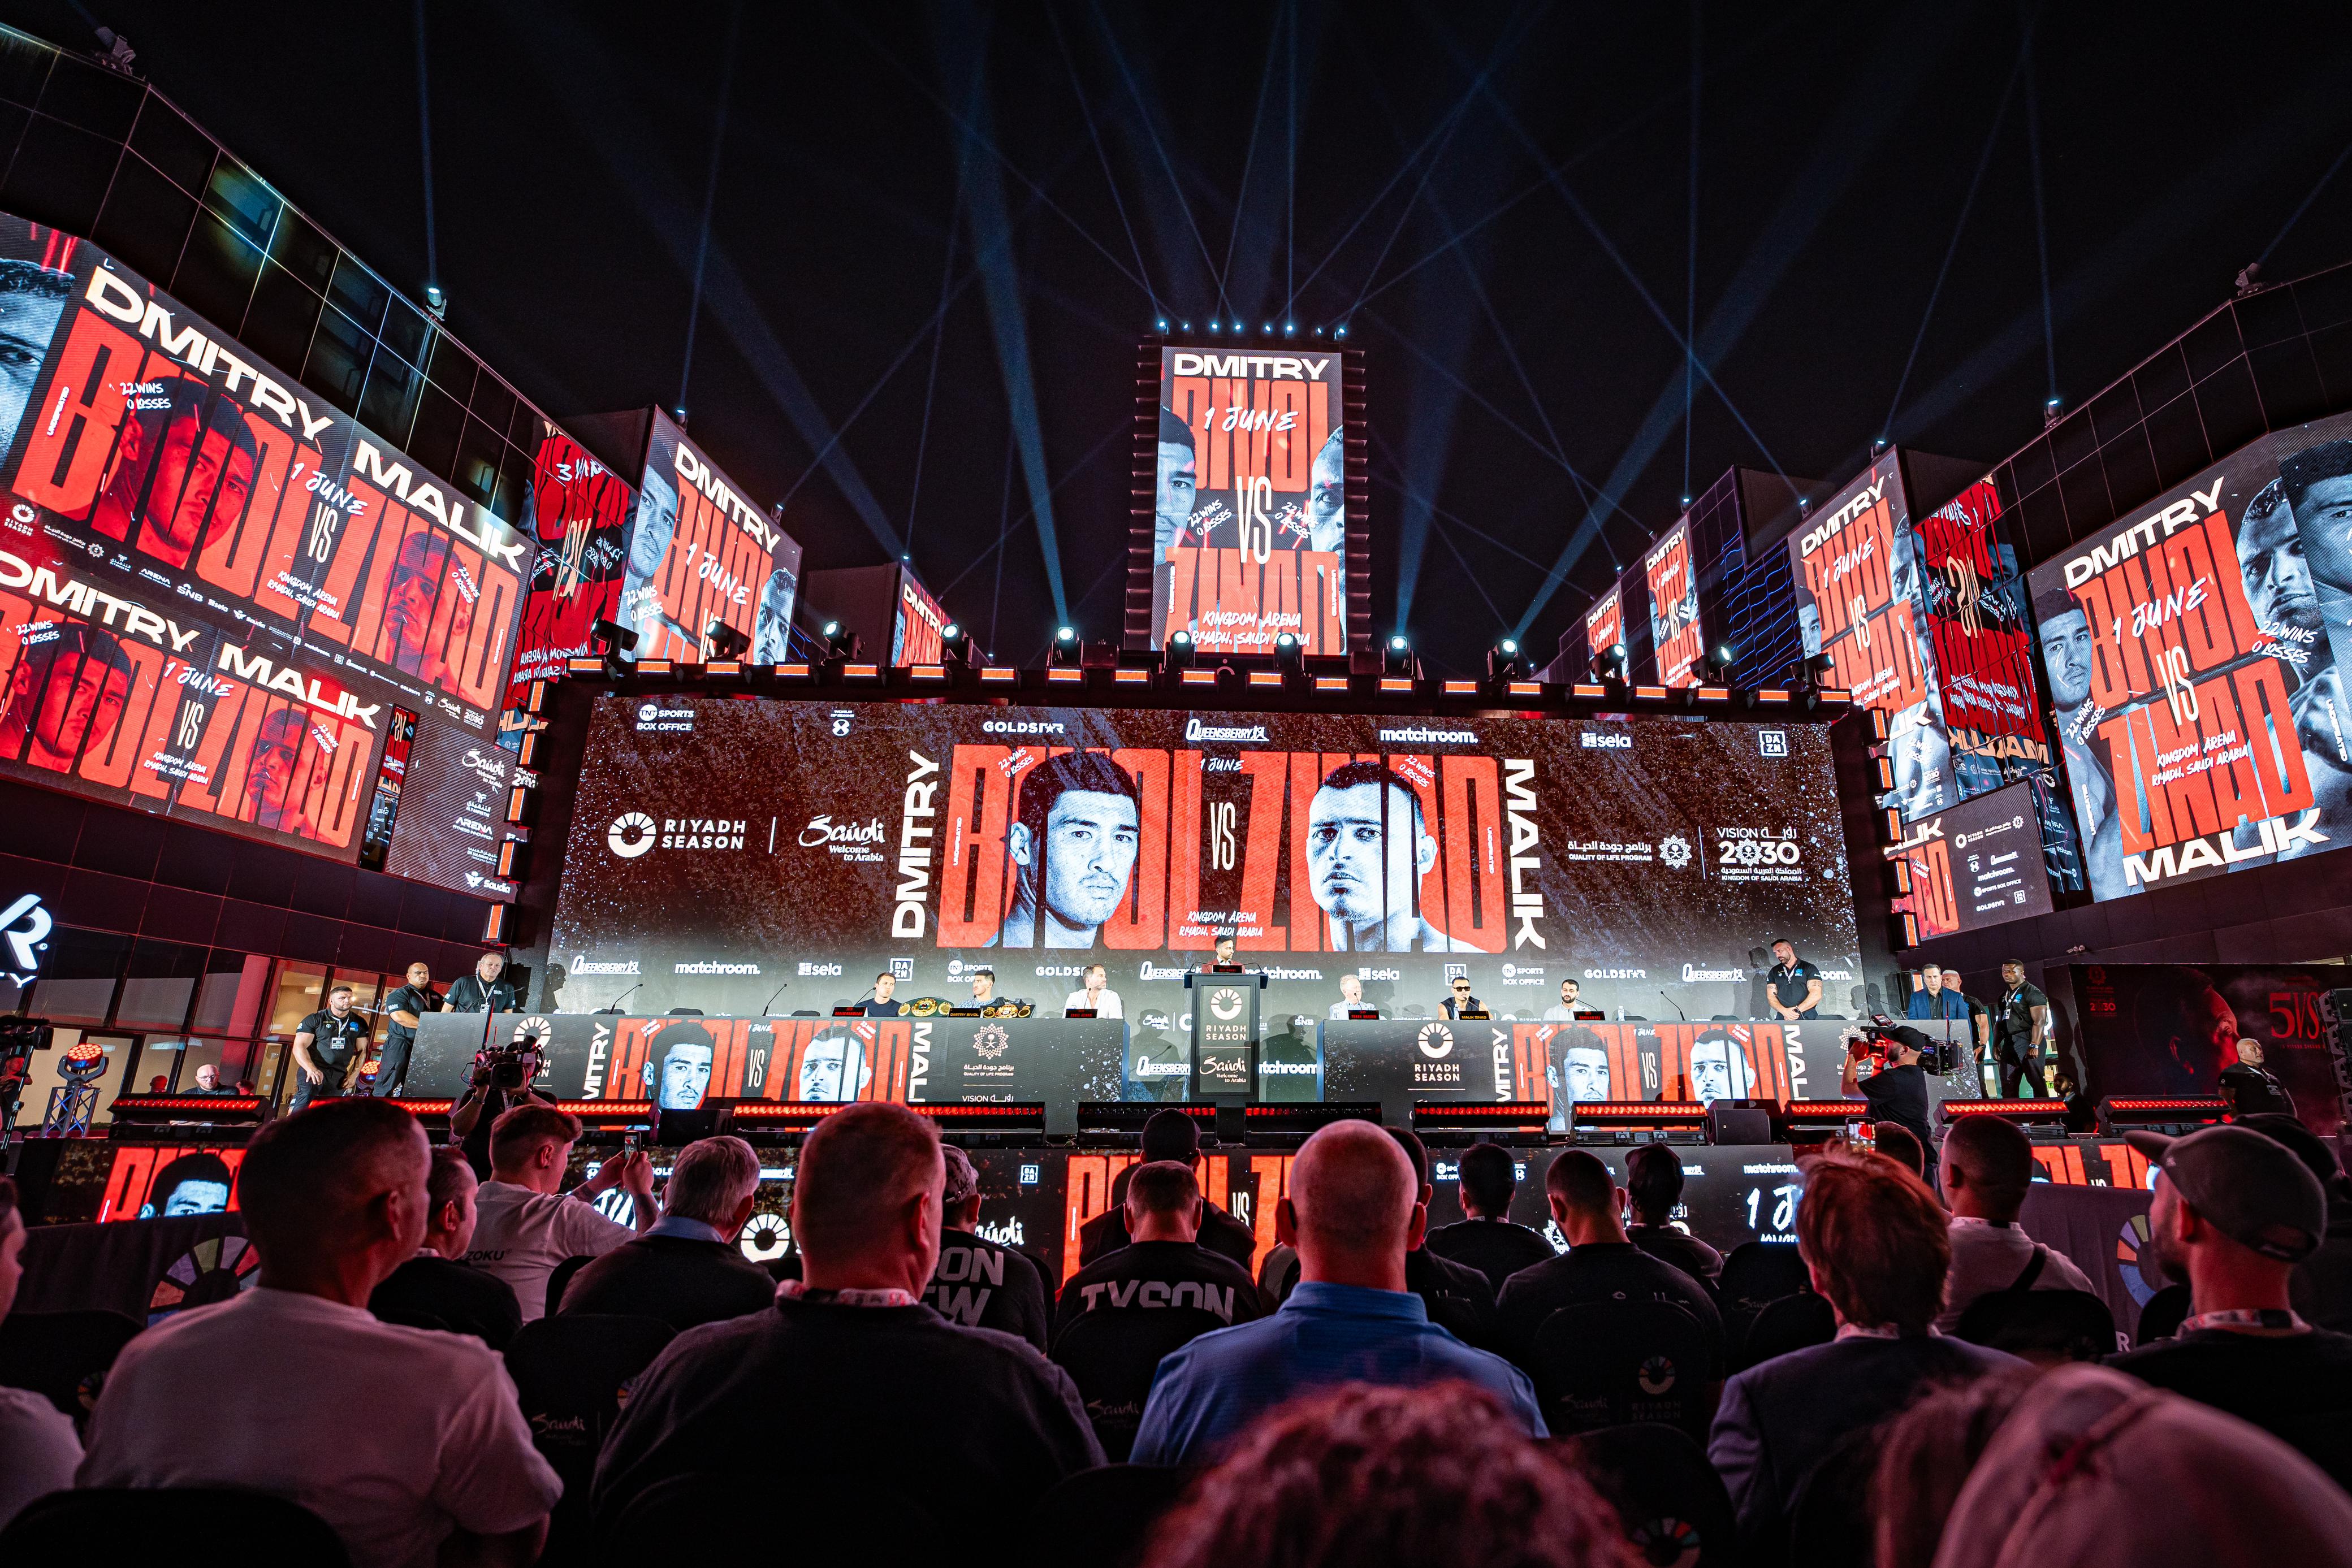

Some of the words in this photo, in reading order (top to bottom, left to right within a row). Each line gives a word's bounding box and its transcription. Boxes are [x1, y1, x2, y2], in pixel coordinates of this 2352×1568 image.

[85, 266, 334, 440] DMITRY
[1174, 353, 1330, 380] DMITRY
[136, 383, 163, 394] WINS
[136, 397, 171, 410] LOSSES
[1204, 407, 1214, 431] 1
[1222, 406, 1299, 433] JUNE
[1171, 376, 1328, 492] BIVOL
[291, 462, 305, 480] 1
[306, 468, 368, 516] JUNE
[675, 442, 781, 554] DMITRY
[353, 439, 526, 574] MALIK
[1200, 500, 1222, 520] WINS
[1800, 475, 1884, 557] DMITRY
[4, 521, 32, 536] SEASON
[5, 517, 34, 532] RIYADH
[1204, 509, 1233, 532] LOSSES
[1236, 475, 1273, 564] VS
[1282, 516, 1311, 539] LOSSES
[1294, 508, 1319, 530] WINS
[308, 502, 338, 563] VS
[2064, 476, 2225, 590] DMITRY
[1646, 526, 1685, 573] DMITRY
[1661, 561, 1680, 583] JUNE
[1823, 568, 1829, 588] 1
[1832, 535, 1875, 582] JUNE
[141, 568, 171, 584] ARENA
[686, 543, 698, 566] 1
[698, 552, 751, 607] JUNE
[176, 586, 204, 602] SNB
[277, 570, 312, 592] KINGDOM
[313, 590, 338, 607] ARENA
[637, 584, 658, 602] WINS
[0, 551, 200, 652] DMITRY
[295, 593, 317, 609] SAUDI
[316, 602, 340, 620] ARABIA
[637, 603, 664, 620] LOSSES
[1588, 591, 1619, 627] DMITRY
[2112, 614, 2122, 644] 1
[2132, 577, 2209, 638] JUNE
[29, 620, 53, 633] WINS
[1203, 610, 1257, 627] KINGDOM
[1261, 611, 1302, 627] ARENA
[1668, 598, 1680, 643] VS
[1848, 594, 1871, 652] VS
[29, 630, 60, 645] LOSSES
[1236, 631, 1270, 645] SAUDI
[2279, 623, 2316, 644] WINS
[2263, 643, 2310, 664] LOSSES
[163, 662, 172, 678] 1
[176, 666, 235, 698] JUNE
[218, 642, 381, 730] MALIK
[1874, 665, 1893, 686] ARENA
[2156, 646, 2199, 727] VS
[2077, 698, 2094, 724] WINS
[176, 699, 205, 748] VS
[2082, 705, 2107, 740] LOSSES
[1380, 727, 1478, 743] matchroom.
[1597, 735, 1632, 748] sela
[1008, 747, 1027, 765] WINS
[2156, 743, 2199, 767] KINGDOM
[2203, 729, 2237, 752] ARENA
[152, 750, 184, 768] KINGDOM
[184, 762, 207, 774] ARENA
[461, 748, 505, 778] Saudi
[1010, 755, 1035, 775] LOSSES
[1200, 759, 1206, 770] 1
[1208, 758, 1244, 772] JUNE
[1415, 761, 1436, 779] WINS
[2186, 759, 2215, 778] SAUDI
[2216, 744, 2249, 765] ARABIA
[168, 766, 189, 779] SAUDI
[188, 770, 210, 785] ARABIA
[1403, 766, 1430, 787] LOSSES
[455, 817, 493, 835] ARENA
[664, 819, 747, 834] RIYADH
[798, 814, 886, 847] Saudi
[1210, 802, 1236, 870] VS
[1716, 827, 1758, 839] VISION
[662, 835, 744, 850] SEASON
[828, 845, 870, 854] Welcome
[891, 750, 939, 938] DMITRY
[1600, 841, 1623, 852] جودة
[1626, 841, 1652, 852] برنامج
[2122, 806, 2331, 889] MALIK
[1504, 759, 1546, 950] MALIK
[1187, 911, 1228, 924] KINGDOM
[1229, 911, 1256, 924] ARENA
[1211, 926, 1235, 937] SAUDI
[1236, 926, 1263, 937] ARABIA
[675, 960, 761, 974] matchroom.
[812, 962, 842, 976] sela
[1371, 967, 1400, 980] sela
[749, 1049, 764, 1088] VS
[1200, 1056, 1246, 1075] Saudi
[1415, 1064, 1460, 1073] RIYADH
[1642, 1051, 1658, 1090] VS
[1415, 1073, 1460, 1082] SEASON
